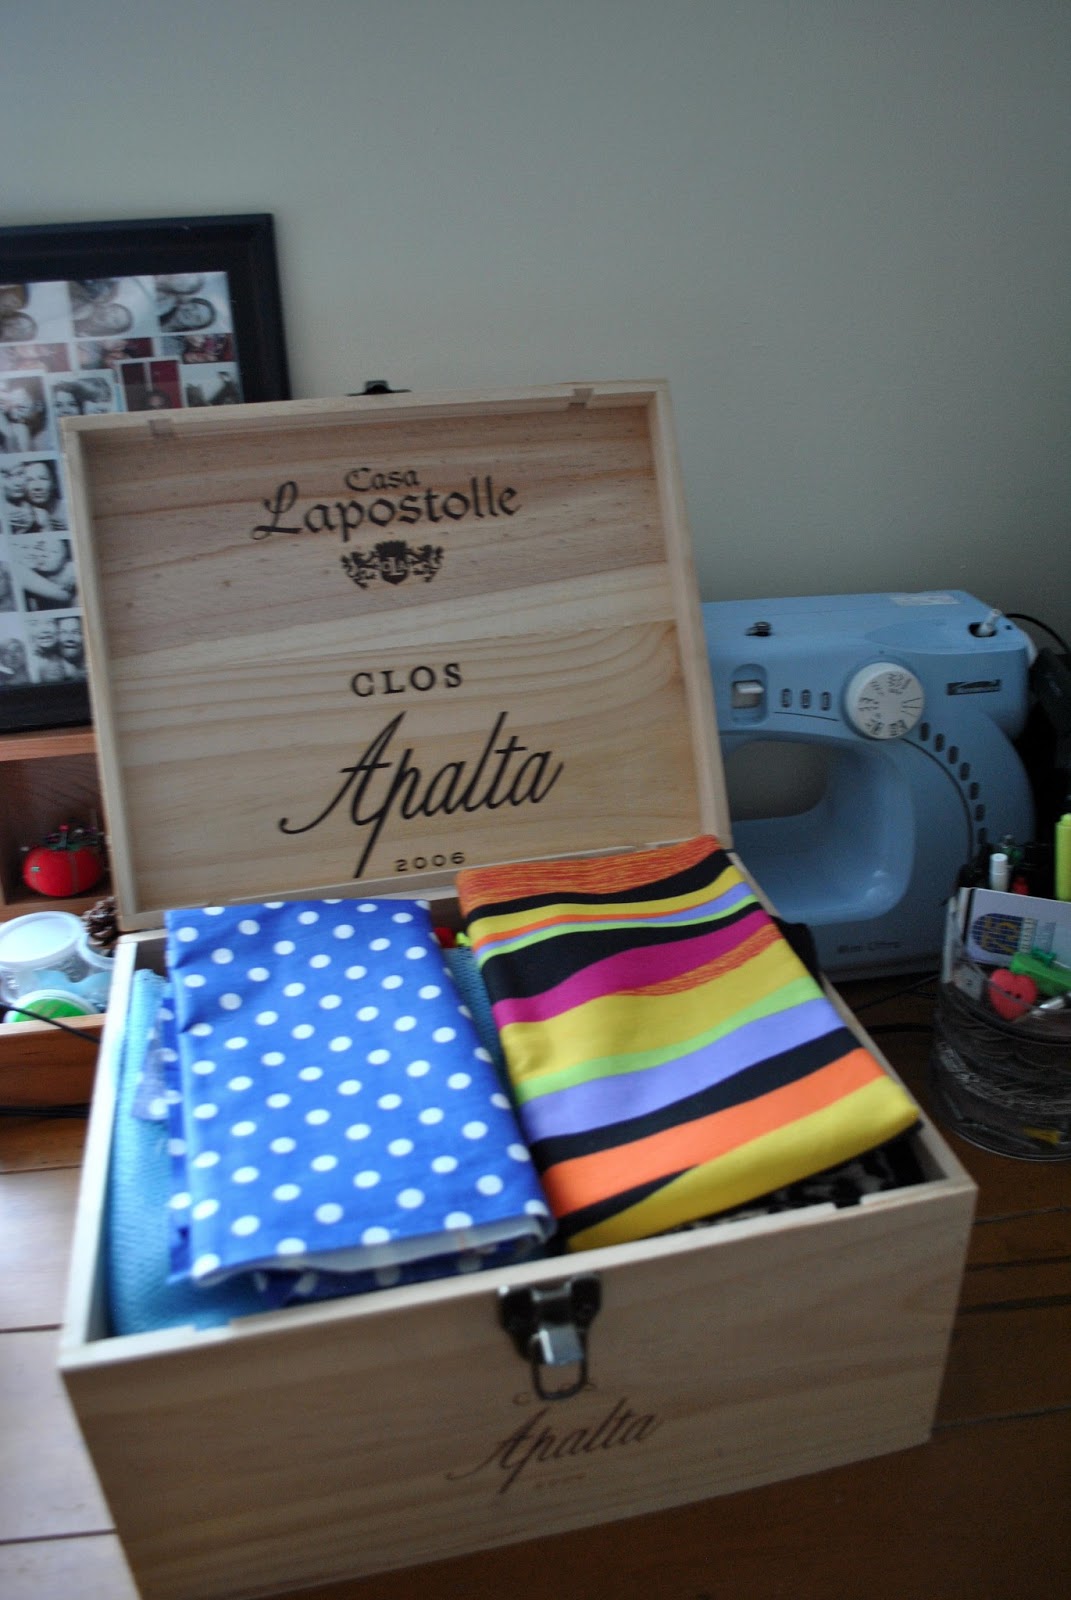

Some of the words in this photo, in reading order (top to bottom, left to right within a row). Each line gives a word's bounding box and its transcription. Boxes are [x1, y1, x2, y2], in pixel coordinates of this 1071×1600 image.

[344, 467, 420, 492] Casa
[252, 475, 522, 542] Lapostolle
[351, 662, 464, 698] CLOS
[278, 710, 564, 879] Apalta
[395, 851, 466, 873] 2006
[445, 1398, 658, 1494] Apalta
